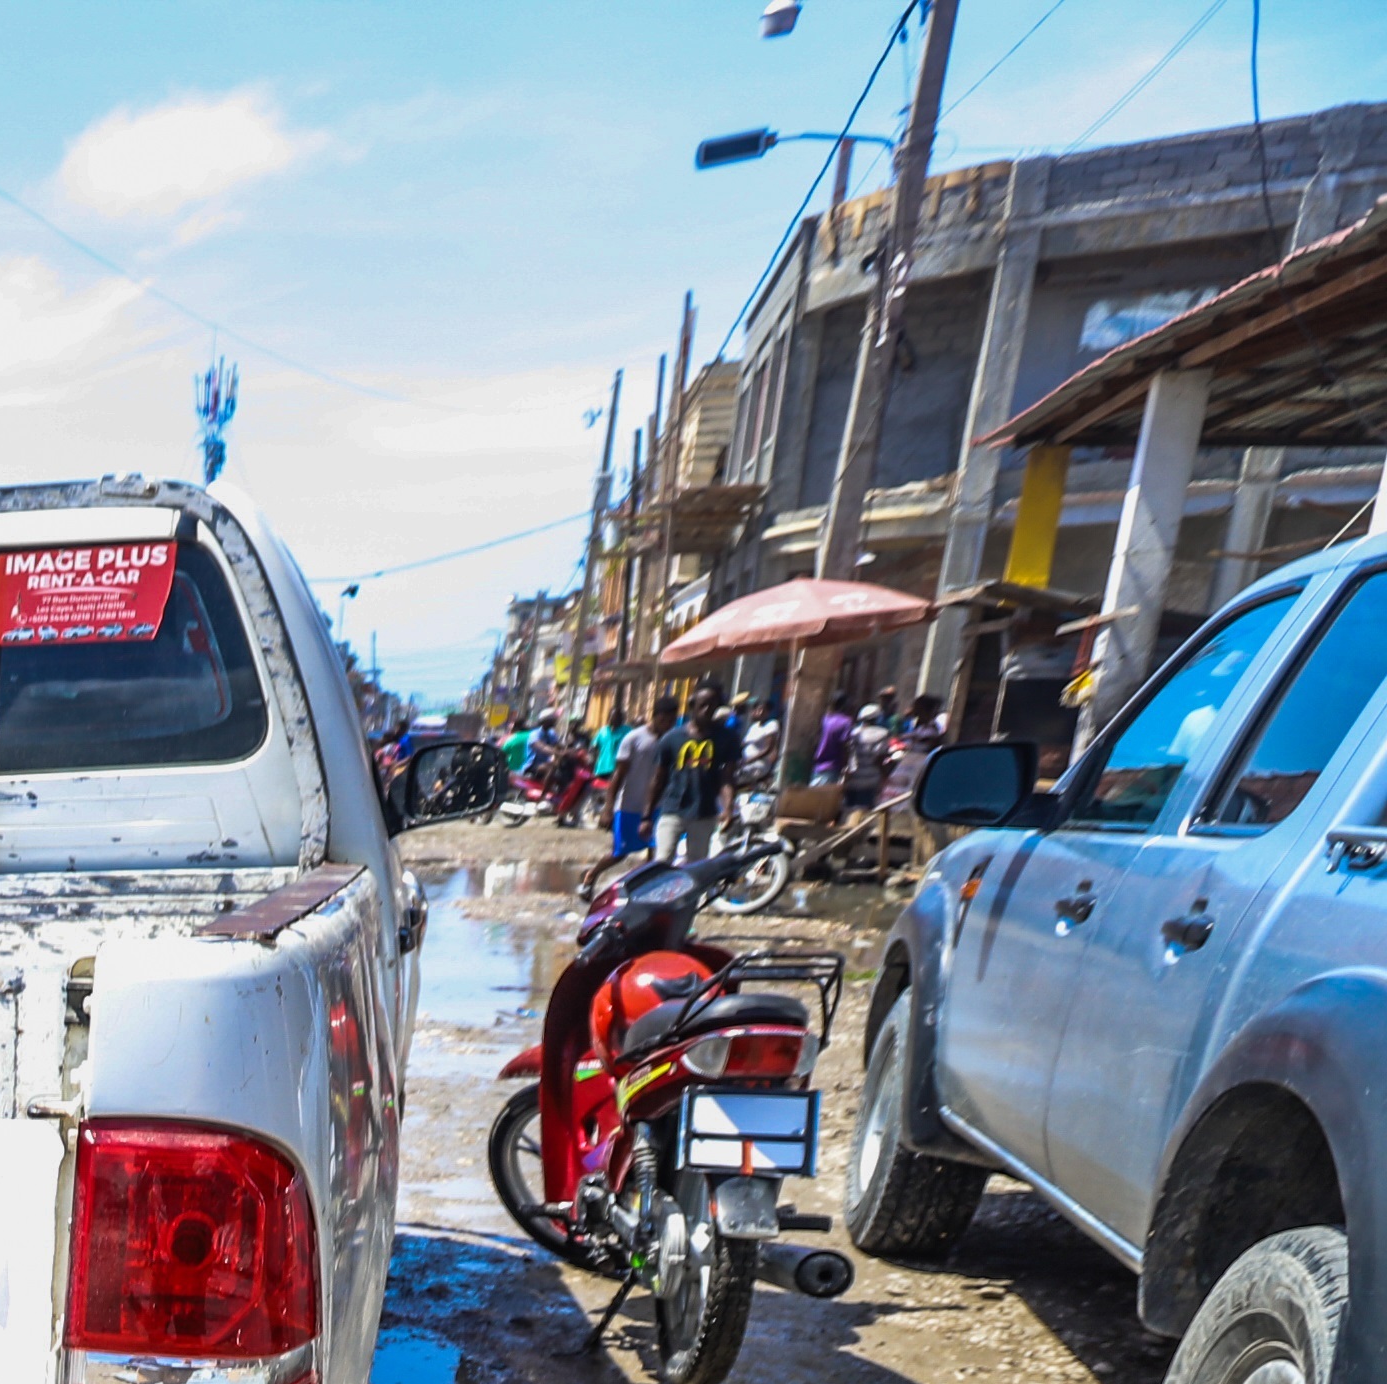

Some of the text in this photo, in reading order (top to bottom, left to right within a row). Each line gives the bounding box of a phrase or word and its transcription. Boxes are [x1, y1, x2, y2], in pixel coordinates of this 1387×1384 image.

[5, 545, 169, 575] IMAGE PLUS
[27, 569, 141, 590] RENT-A-CAR
